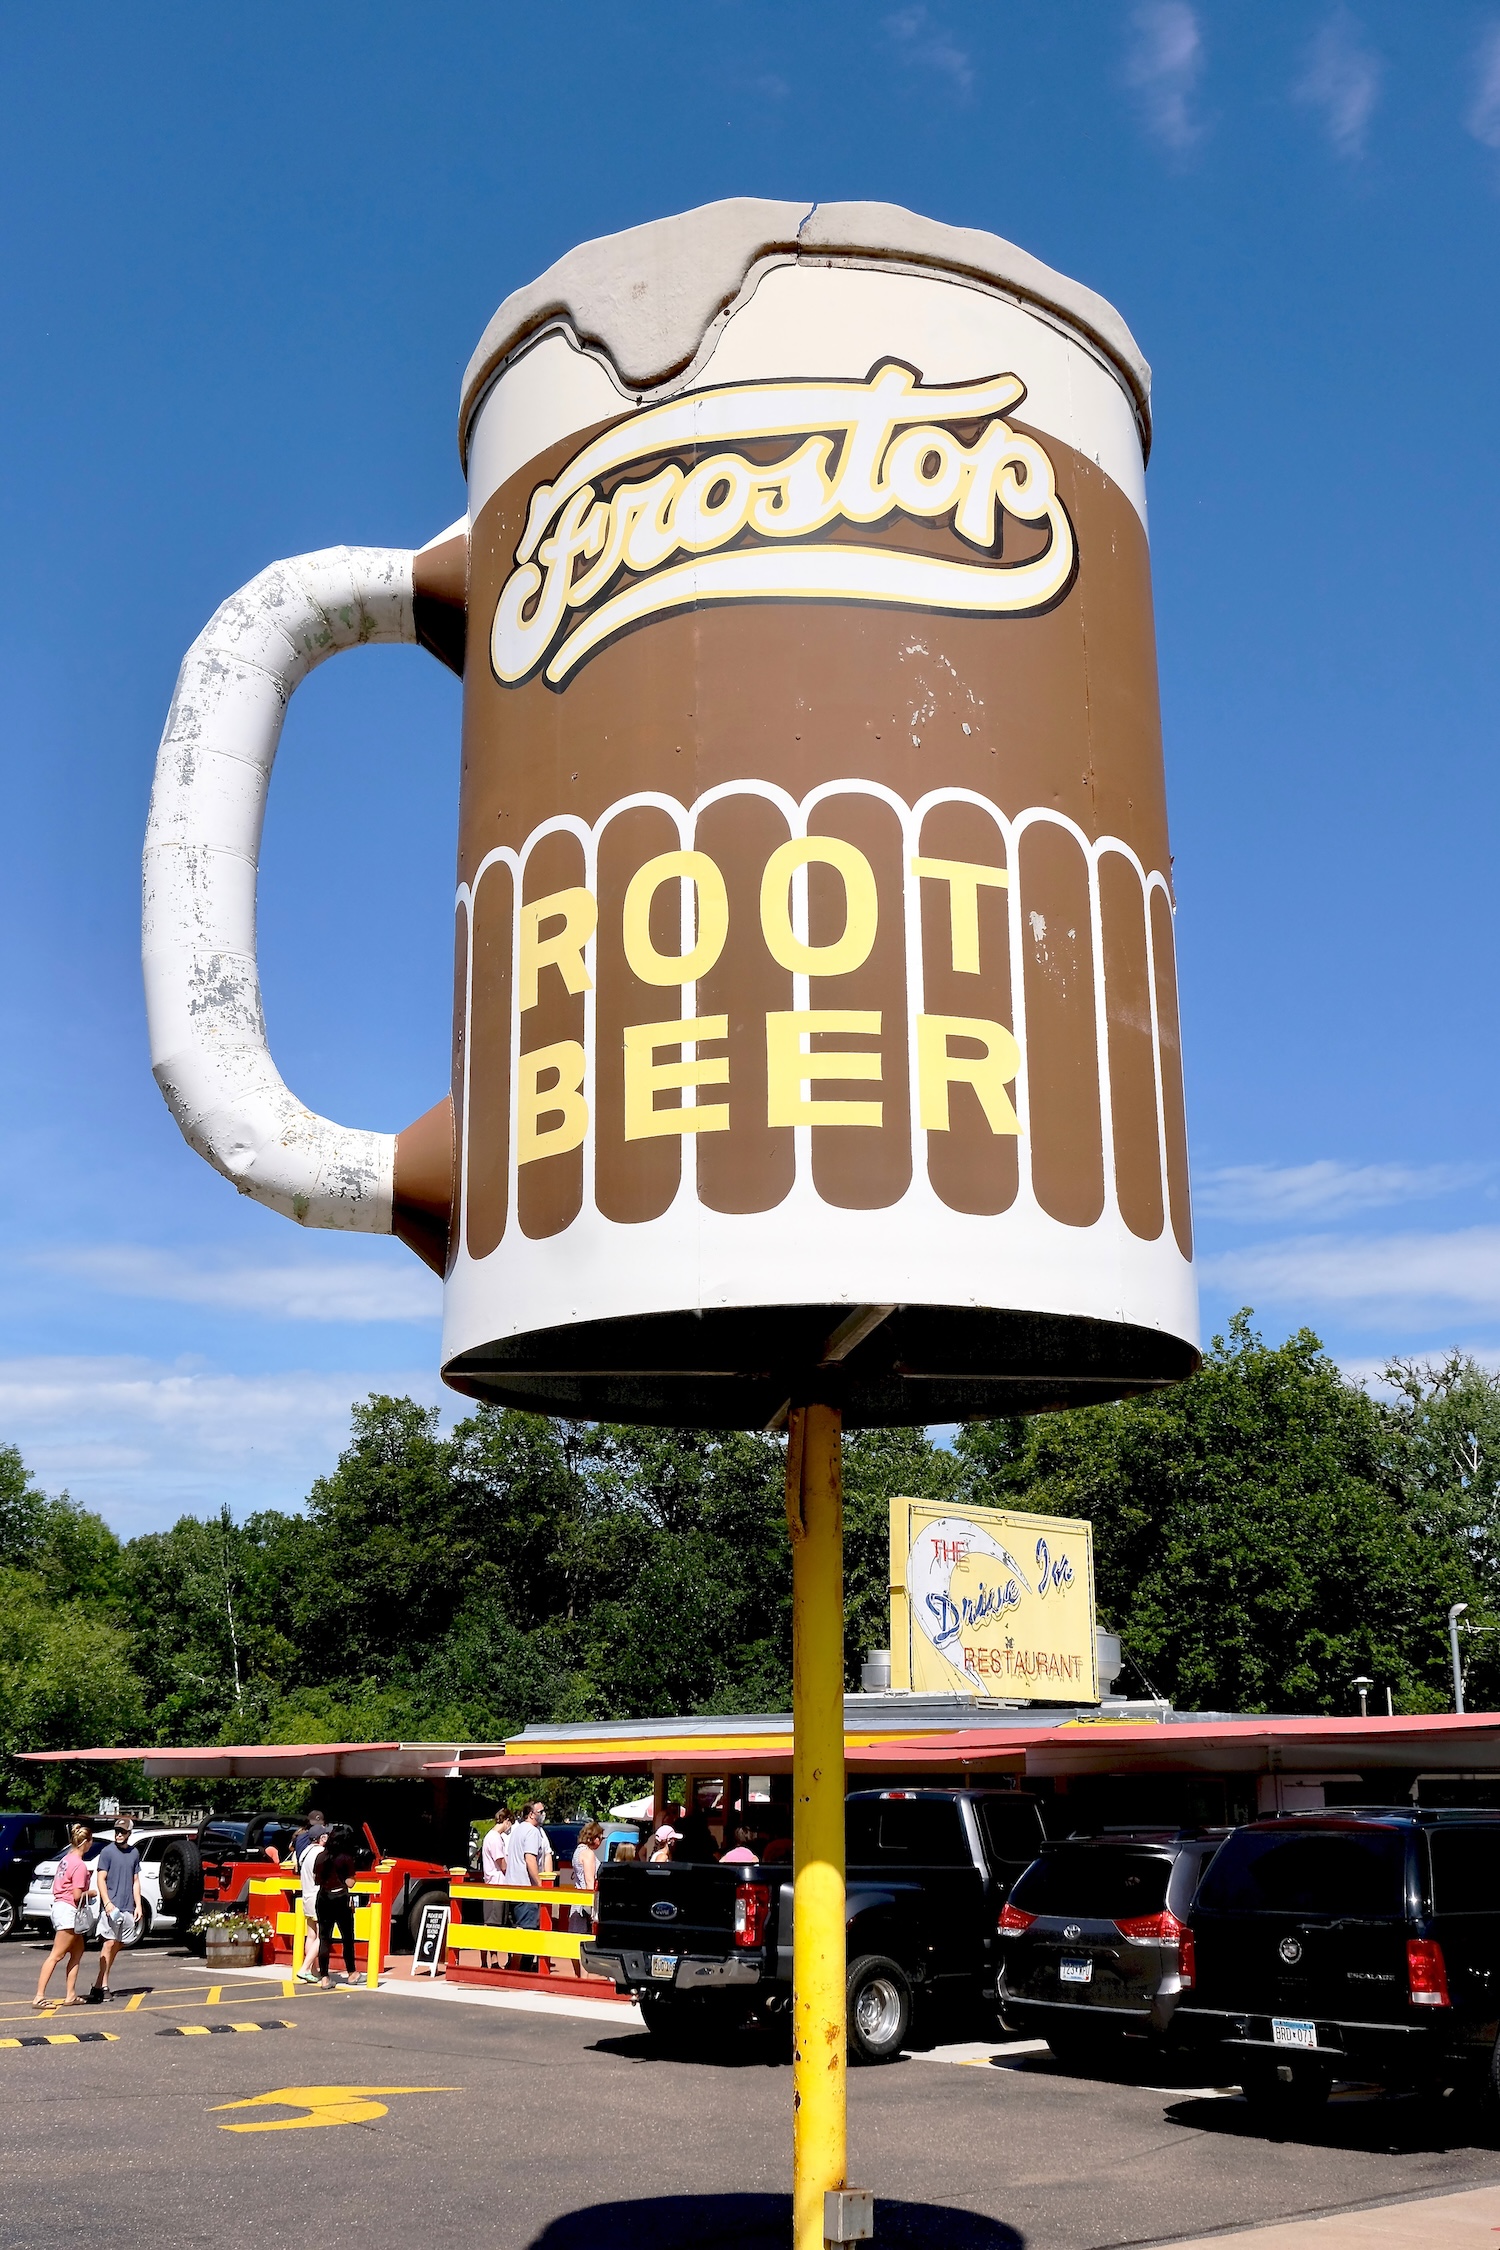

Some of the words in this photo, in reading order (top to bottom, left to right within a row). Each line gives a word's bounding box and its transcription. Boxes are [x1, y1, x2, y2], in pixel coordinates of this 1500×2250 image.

[490, 357, 1078, 692] Frostop
[519, 836, 1009, 1012] ROOT
[517, 1010, 1024, 1166] BEER
[930, 1538, 967, 1564] THE
[926, 1578, 1021, 1645] Drive
[1035, 1537, 1074, 1595] In
[963, 1647, 1083, 1679] RESTAURANT
[1347, 1972, 1396, 1981] ESCALADE
[1275, 2026, 1292, 2041] BRD
[1298, 2028, 1314, 2043] 071
